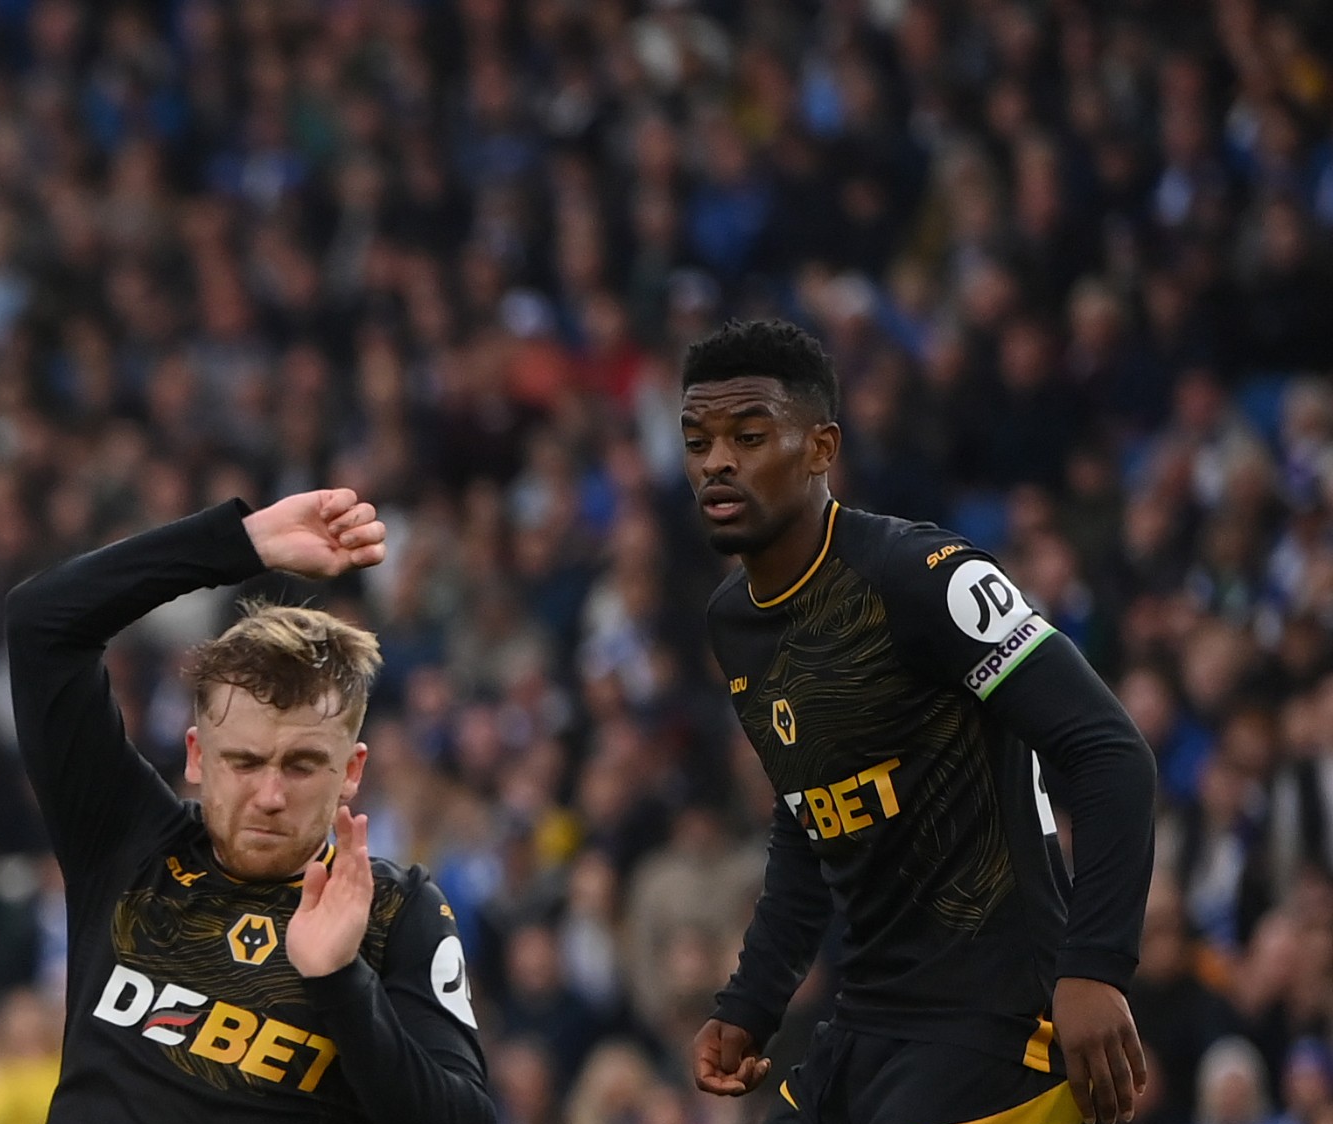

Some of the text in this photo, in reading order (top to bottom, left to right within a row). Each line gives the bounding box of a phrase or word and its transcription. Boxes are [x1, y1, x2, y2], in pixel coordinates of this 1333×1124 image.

[969, 573, 1015, 635] JD
[729, 675, 748, 696] UDU
[966, 622, 1038, 690] Captain
